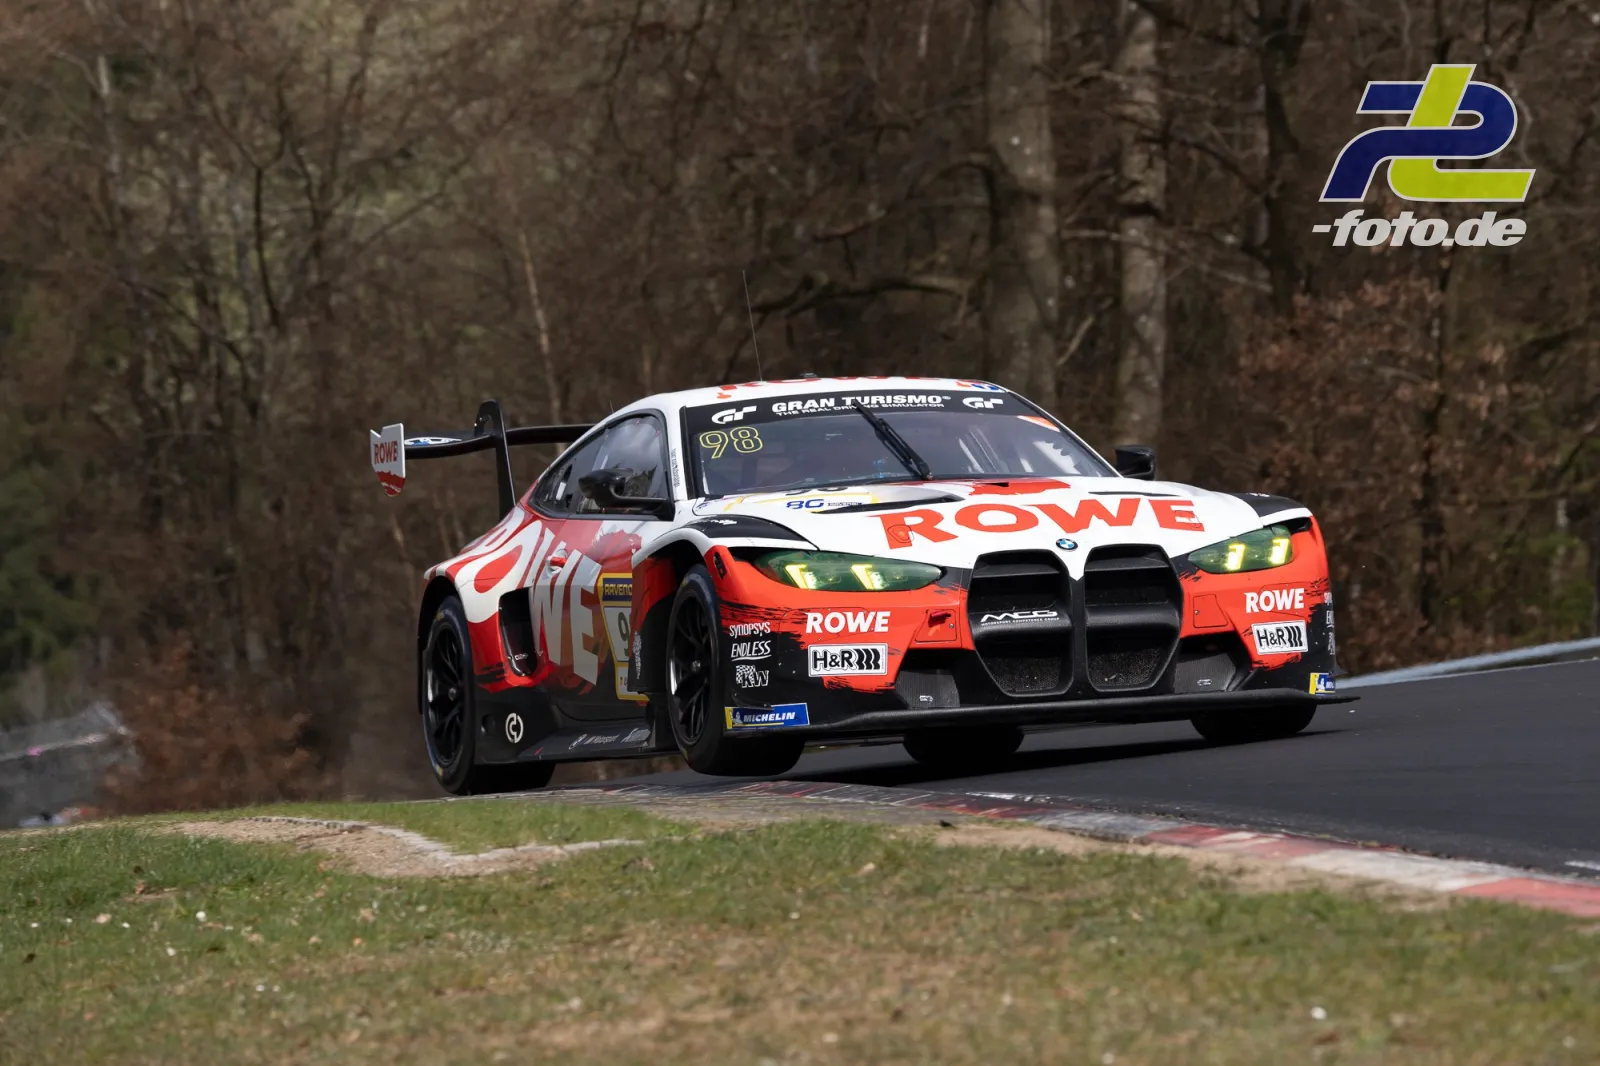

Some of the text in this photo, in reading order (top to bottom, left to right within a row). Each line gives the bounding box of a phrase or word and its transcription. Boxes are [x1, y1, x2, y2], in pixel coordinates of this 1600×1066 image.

[772, 398, 835, 413] GRAN
[373, 441, 398, 464] ROWE
[699, 426, 763, 459] 98
[866, 498, 1205, 549] ROWE
[1244, 588, 1304, 613] ROWE
[729, 621, 771, 639] SYNOPSYS
[805, 611, 891, 633] ROWE
[618, 611, 632, 657] 9
[1256, 626, 1288, 647] H&R
[731, 640, 771, 658] ENDLESS
[812, 648, 857, 671] H&R
[739, 667, 770, 688] KW
[743, 711, 796, 722] MICHELIN
